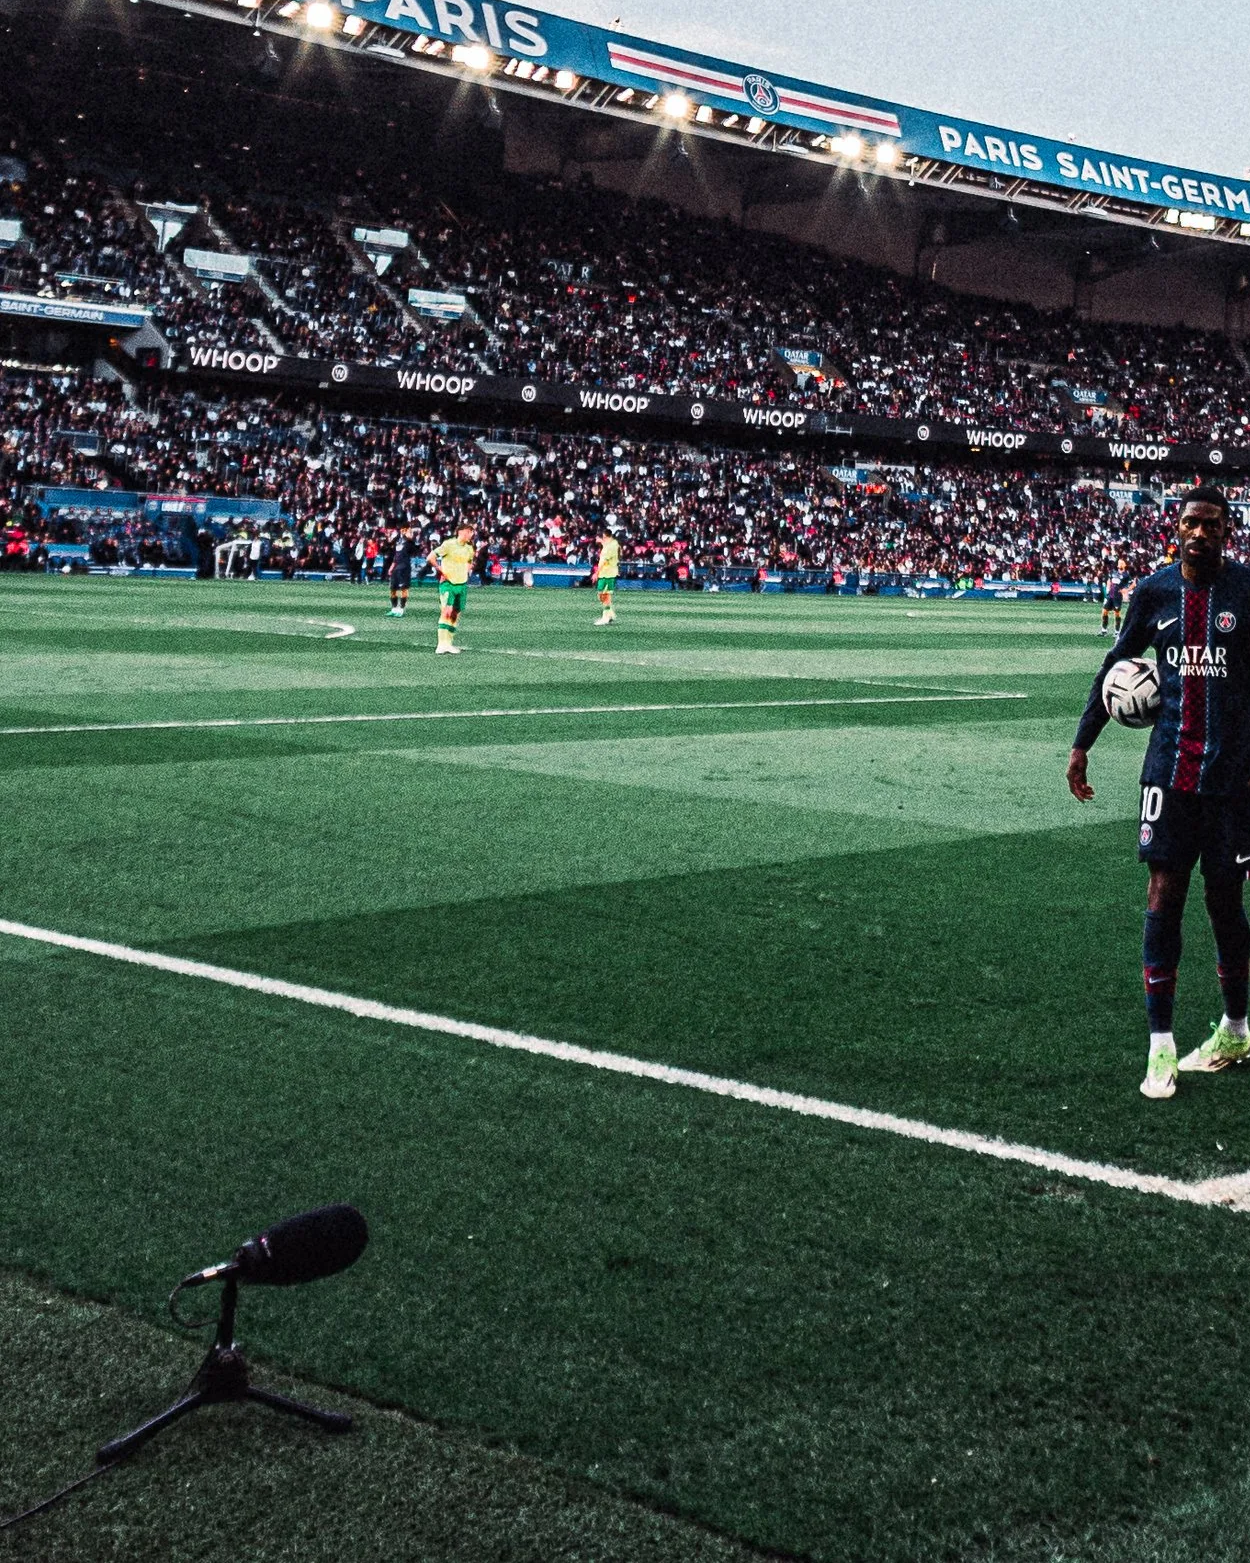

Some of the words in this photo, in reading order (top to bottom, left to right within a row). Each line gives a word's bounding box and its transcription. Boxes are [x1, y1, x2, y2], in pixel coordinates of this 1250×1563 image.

[939, 125, 1043, 171] PARIS
[0, 300, 104, 321] SAINT-GERMAIN
[784, 349, 808, 359] QATAR
[190, 346, 278, 374] WHOOP
[397, 370, 474, 394] WHOOP
[580, 390, 648, 413] WHOOP
[743, 407, 805, 428] WHOOP
[966, 429, 1025, 449] WHOOP
[1109, 442, 1168, 461] WHOOP
[832, 468, 857, 478] QATAR
[1166, 645, 1227, 667] QATAR
[1178, 665, 1228, 677] AIRWAYS
[1141, 786, 1163, 821] 10
